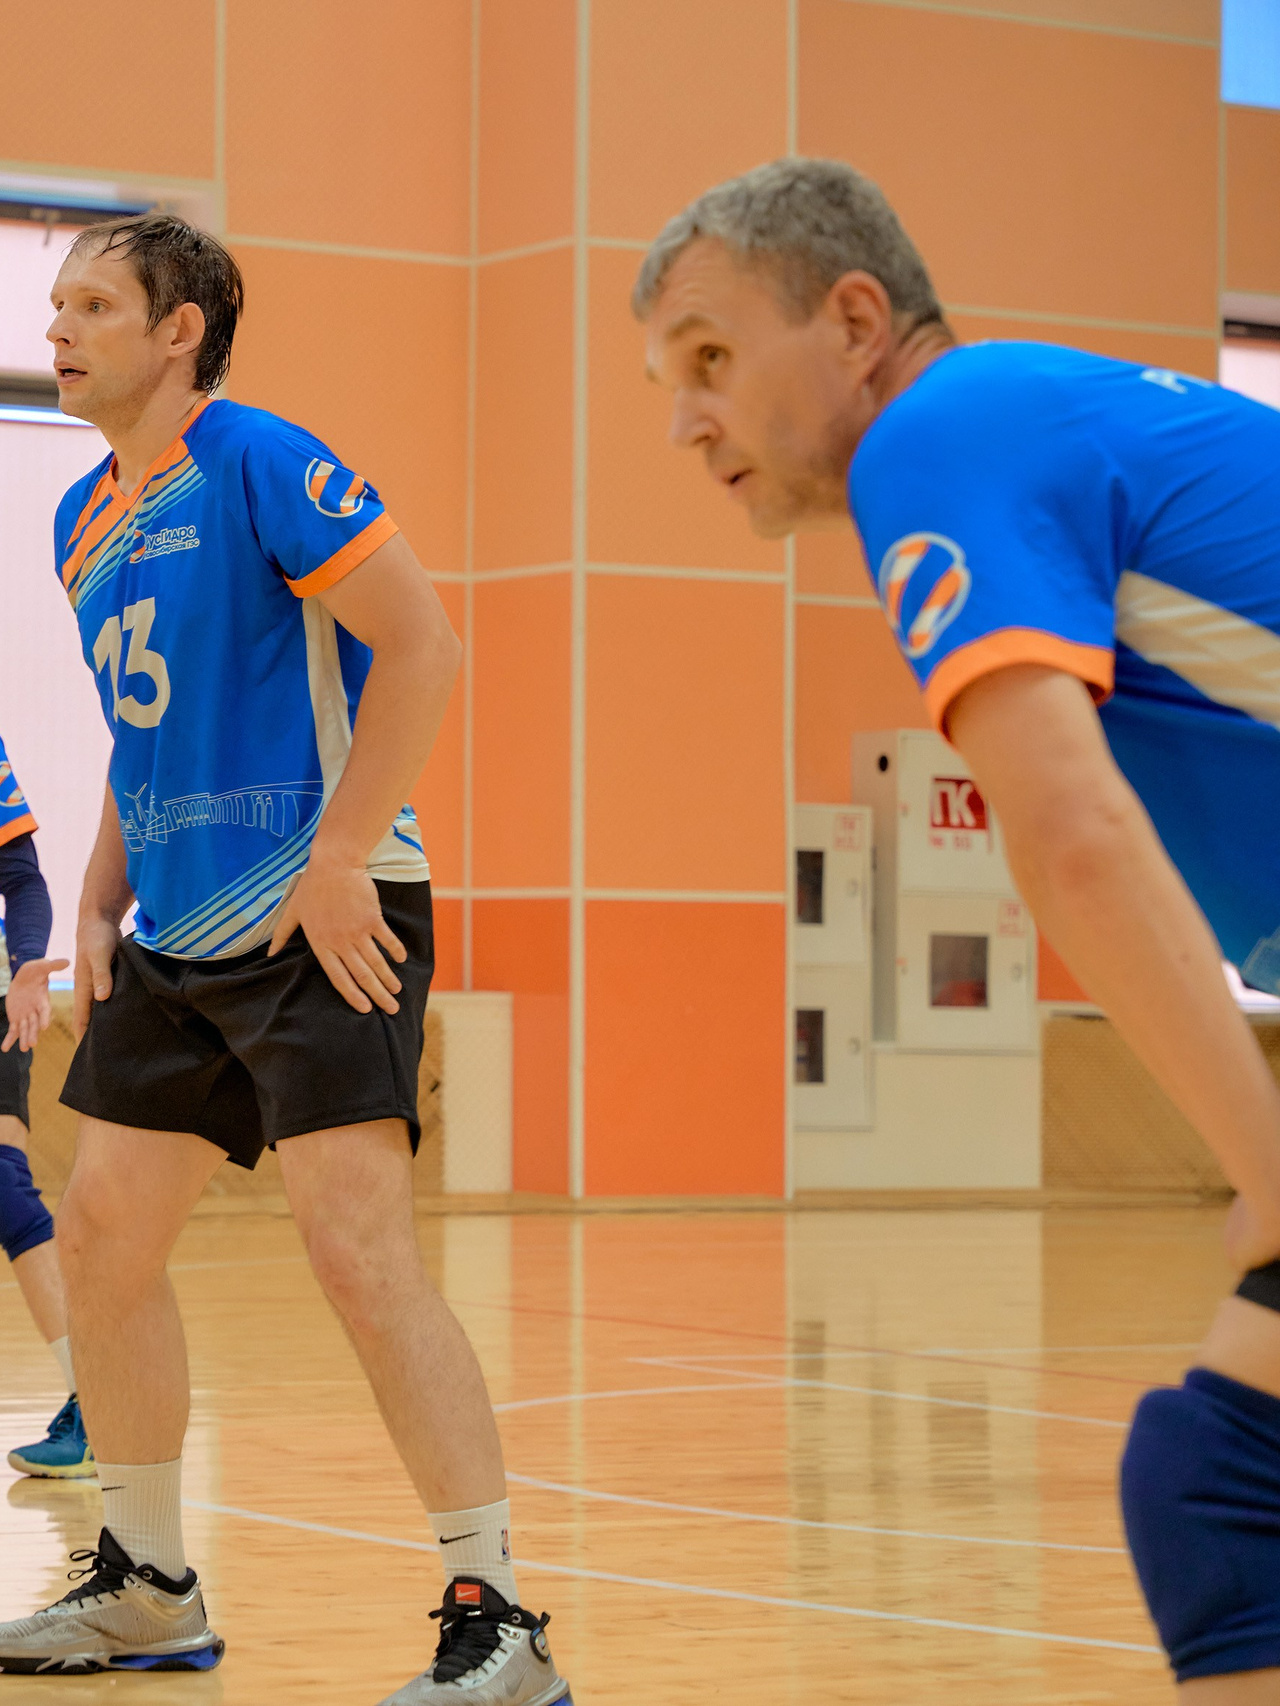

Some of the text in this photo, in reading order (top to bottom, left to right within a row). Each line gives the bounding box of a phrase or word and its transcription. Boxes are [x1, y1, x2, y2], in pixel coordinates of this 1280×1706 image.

[147, 525, 196, 551] усГидро
[92, 597, 171, 729] 13
[932, 781, 976, 827] ПК
